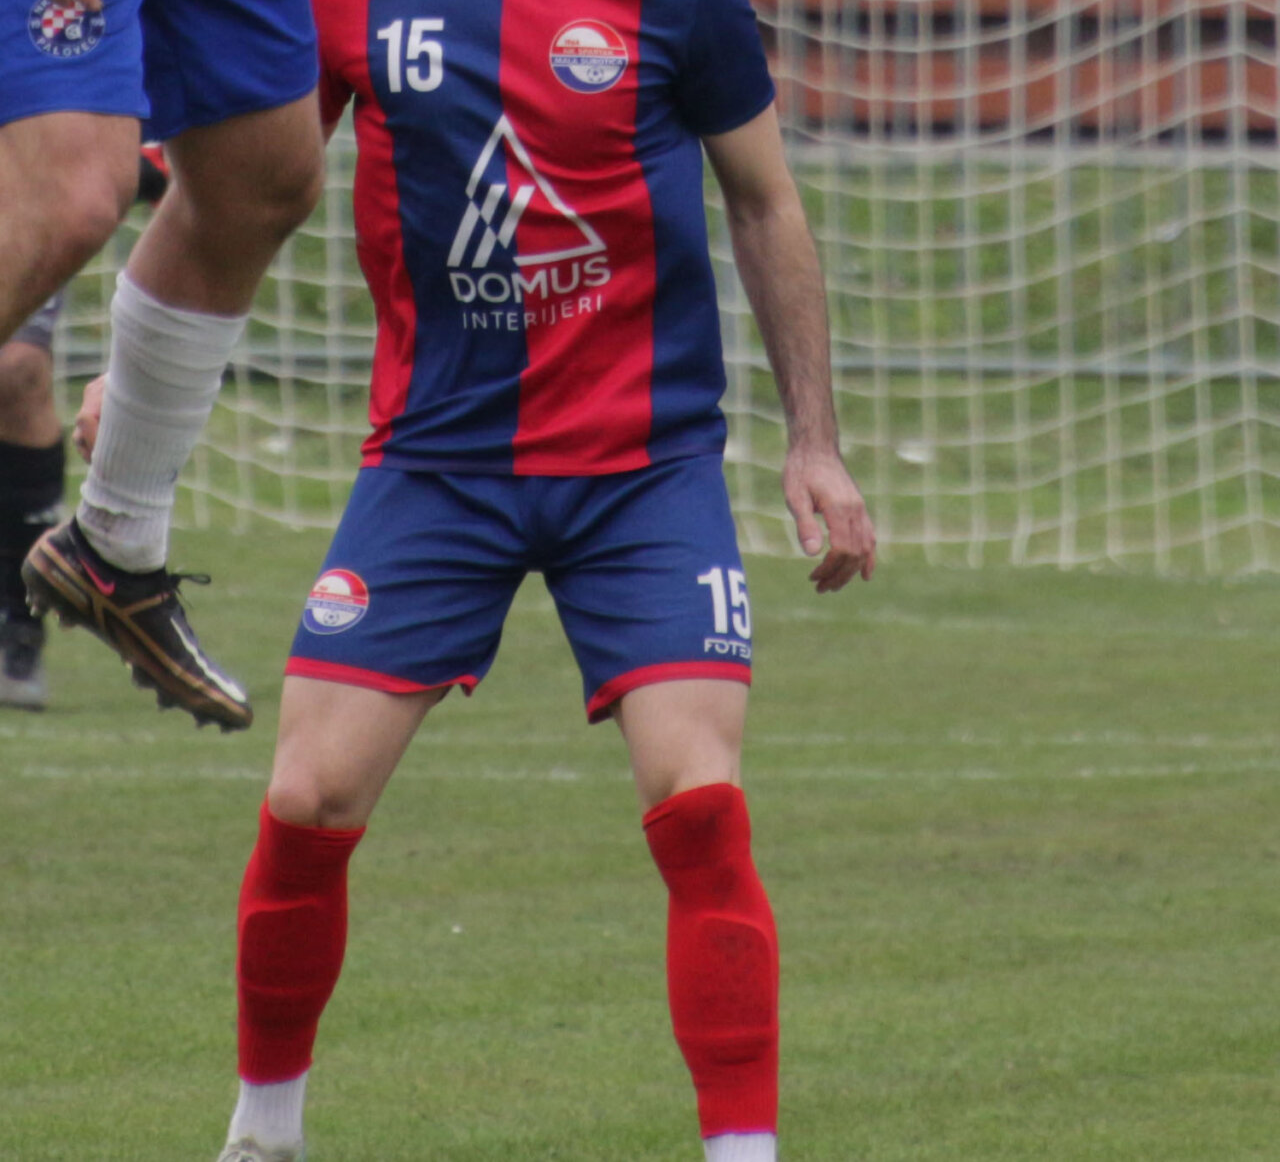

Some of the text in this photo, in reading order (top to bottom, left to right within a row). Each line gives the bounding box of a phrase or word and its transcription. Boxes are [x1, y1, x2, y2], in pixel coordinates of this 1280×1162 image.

[377, 18, 444, 93] 15
[449, 256, 612, 304] DOMUS
[462, 294, 602, 331] INTERIJERI
[697, 567, 751, 639] 15
[704, 638, 751, 659] FOTE
